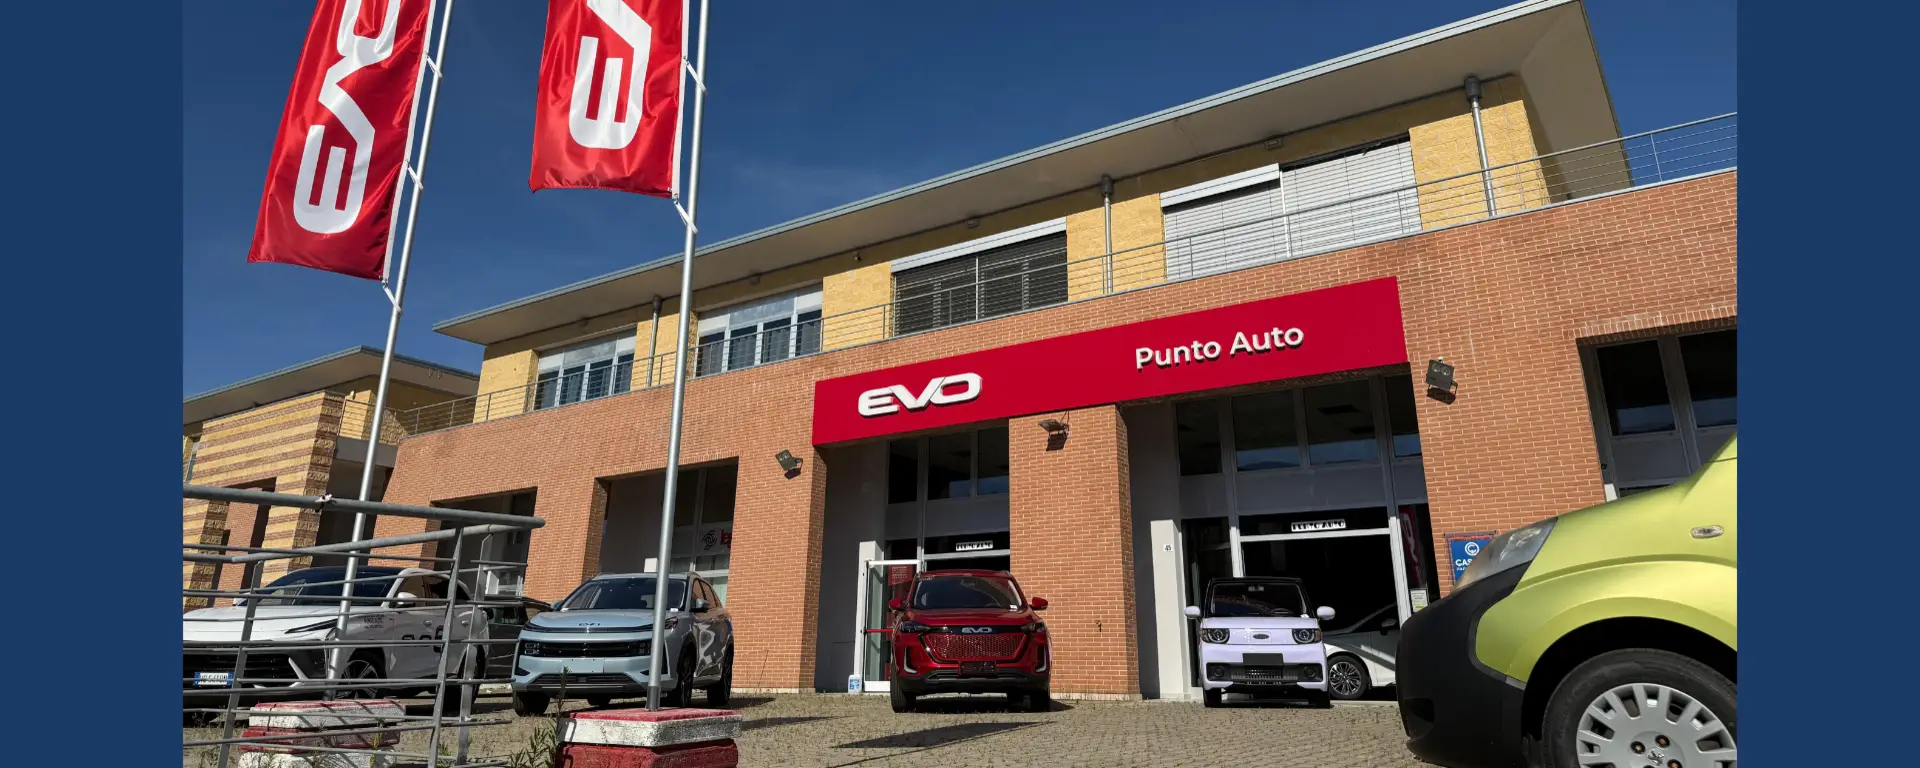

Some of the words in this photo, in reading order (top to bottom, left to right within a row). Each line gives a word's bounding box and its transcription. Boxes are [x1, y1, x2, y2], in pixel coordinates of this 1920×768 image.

[1135, 340, 1221, 370] Punto
[1230, 327, 1304, 355] Auto
[858, 372, 982, 417] EVO
